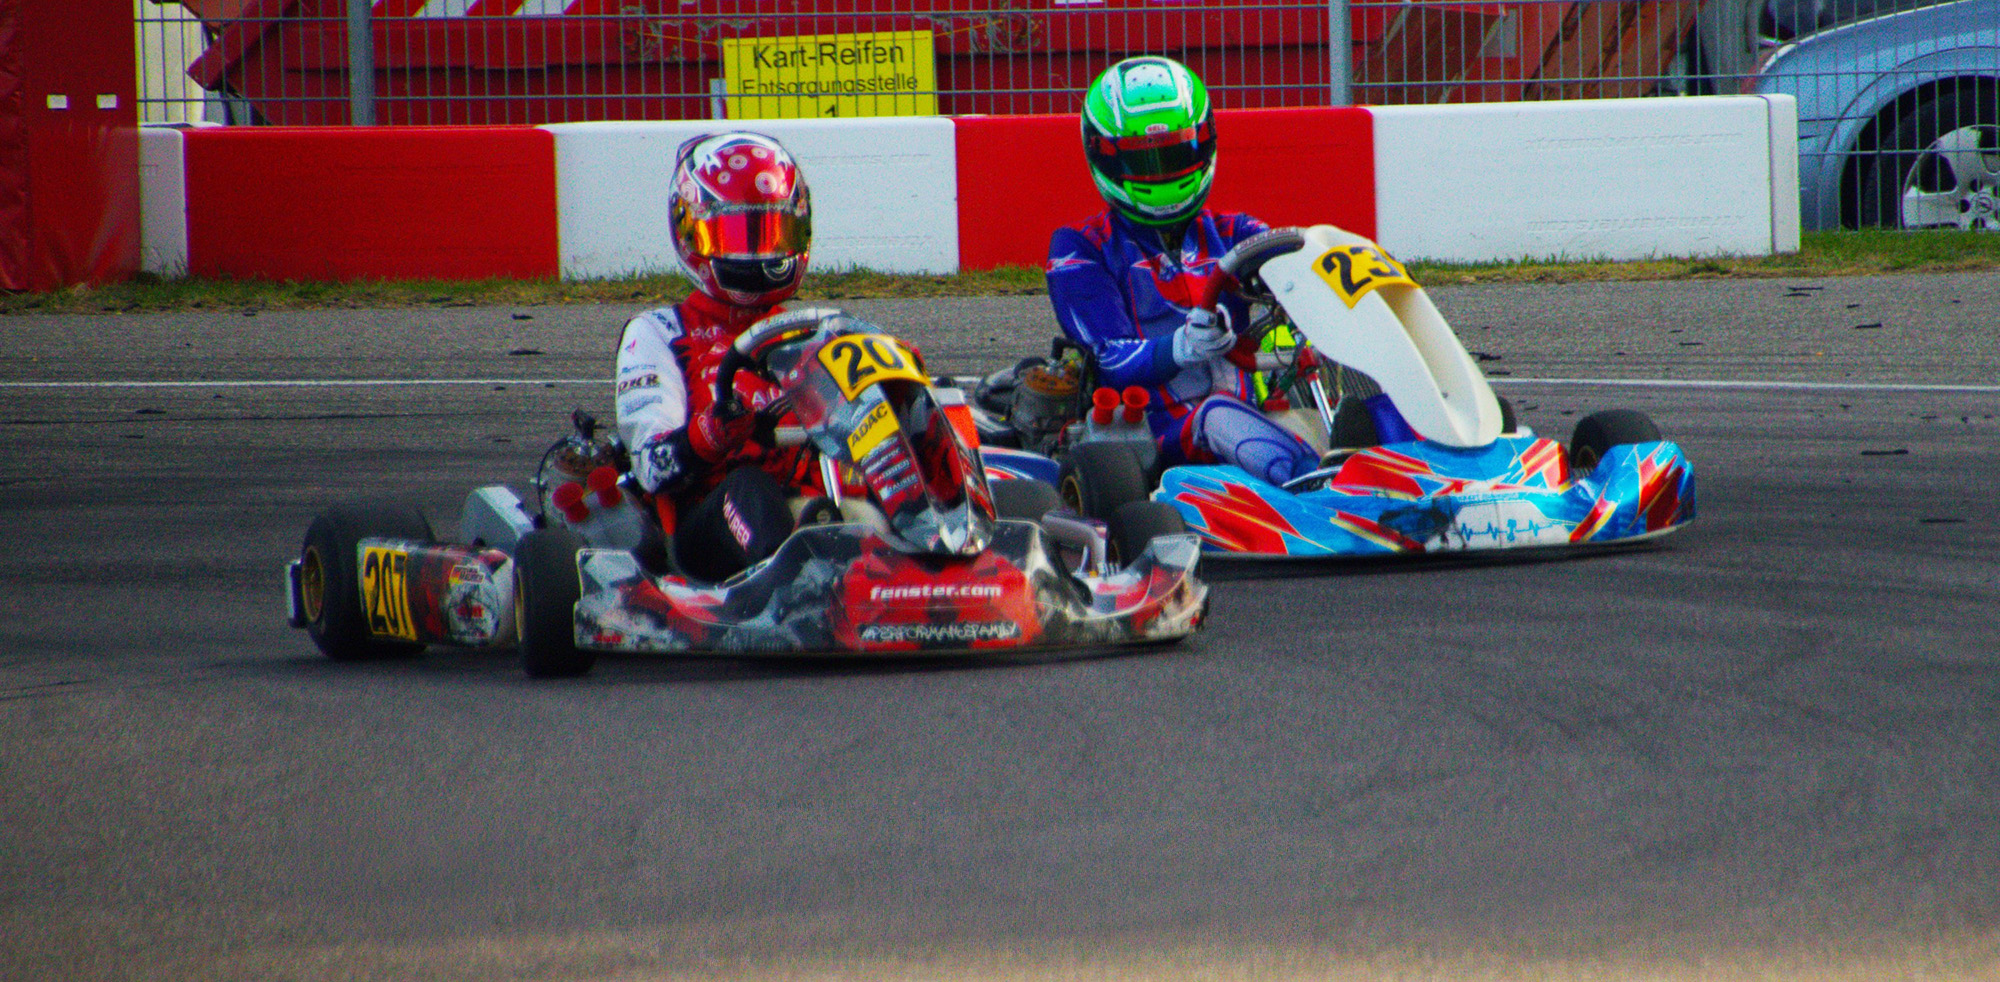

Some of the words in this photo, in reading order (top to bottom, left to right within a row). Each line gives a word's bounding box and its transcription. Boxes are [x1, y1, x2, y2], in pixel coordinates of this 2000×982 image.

[752, 40, 904, 69] Kart-Reifen
[742, 73, 918, 99] Entsorgungsstelle
[1321, 245, 1414, 297] 23
[851, 404, 888, 448] ADAC
[364, 551, 409, 637] 207
[869, 584, 1003, 600] fenster.com
